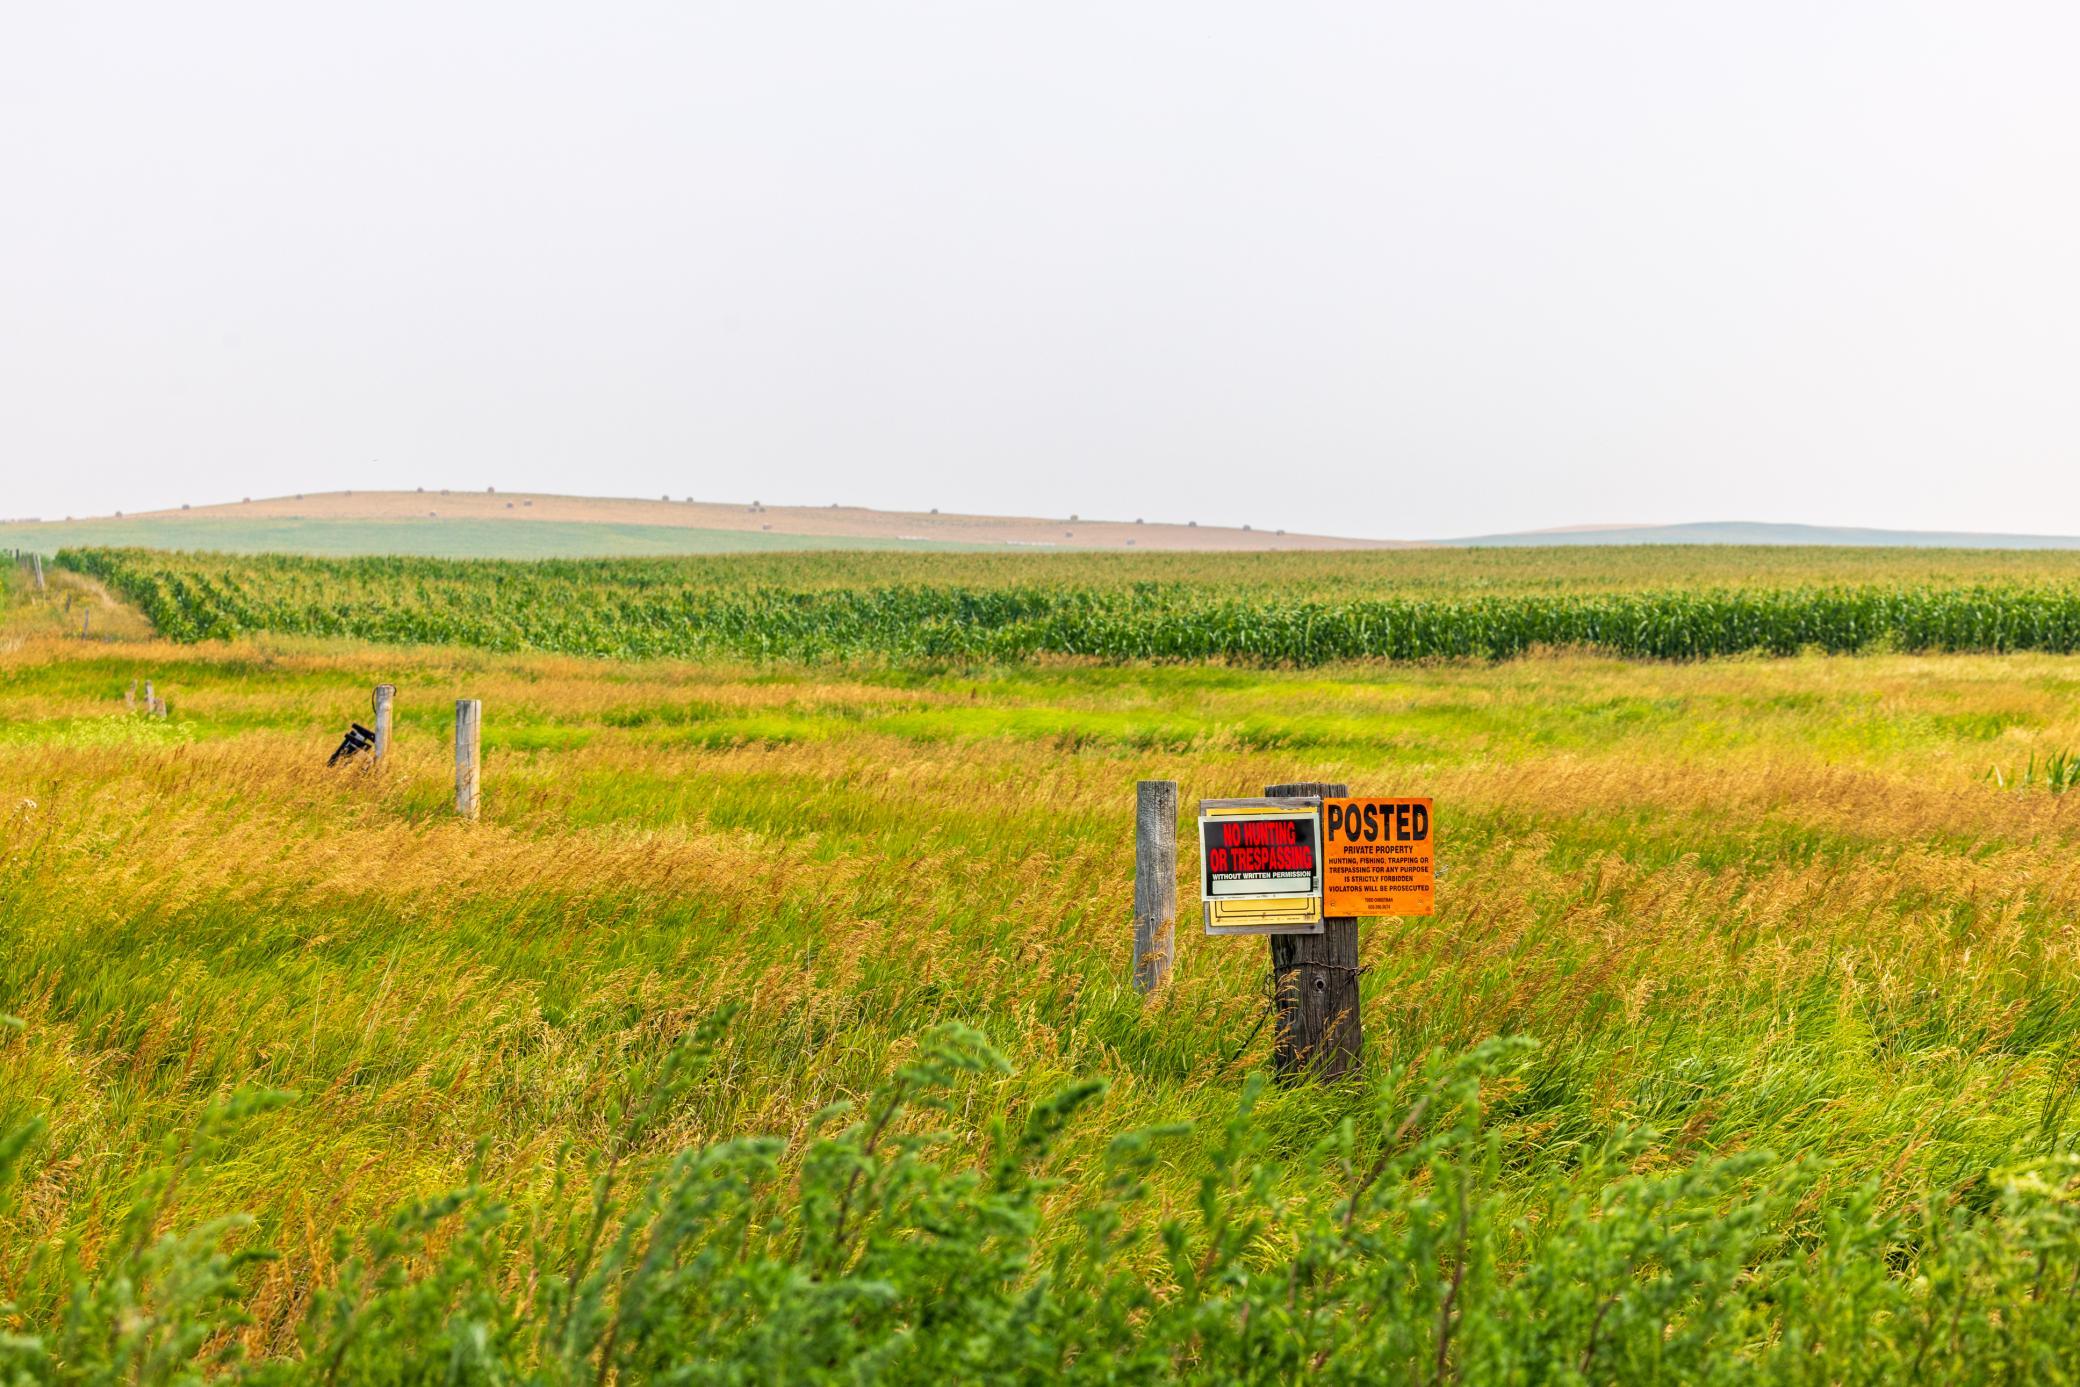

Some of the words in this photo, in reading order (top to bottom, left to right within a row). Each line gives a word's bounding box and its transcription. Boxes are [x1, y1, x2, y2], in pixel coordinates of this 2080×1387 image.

[1223, 823, 1241, 846] NO
[1243, 821, 1296, 846] HUNTING
[1328, 803, 1429, 842] POSTED
[1210, 848, 1229, 872] OR
[1230, 845, 1313, 871] TRESPASSING
[1343, 846, 1374, 854] PRIVATE
[1375, 845, 1413, 854] PROPERTY
[1212, 873, 1242, 881] WITHOUT
[1272, 870, 1312, 879] PERMISSION
